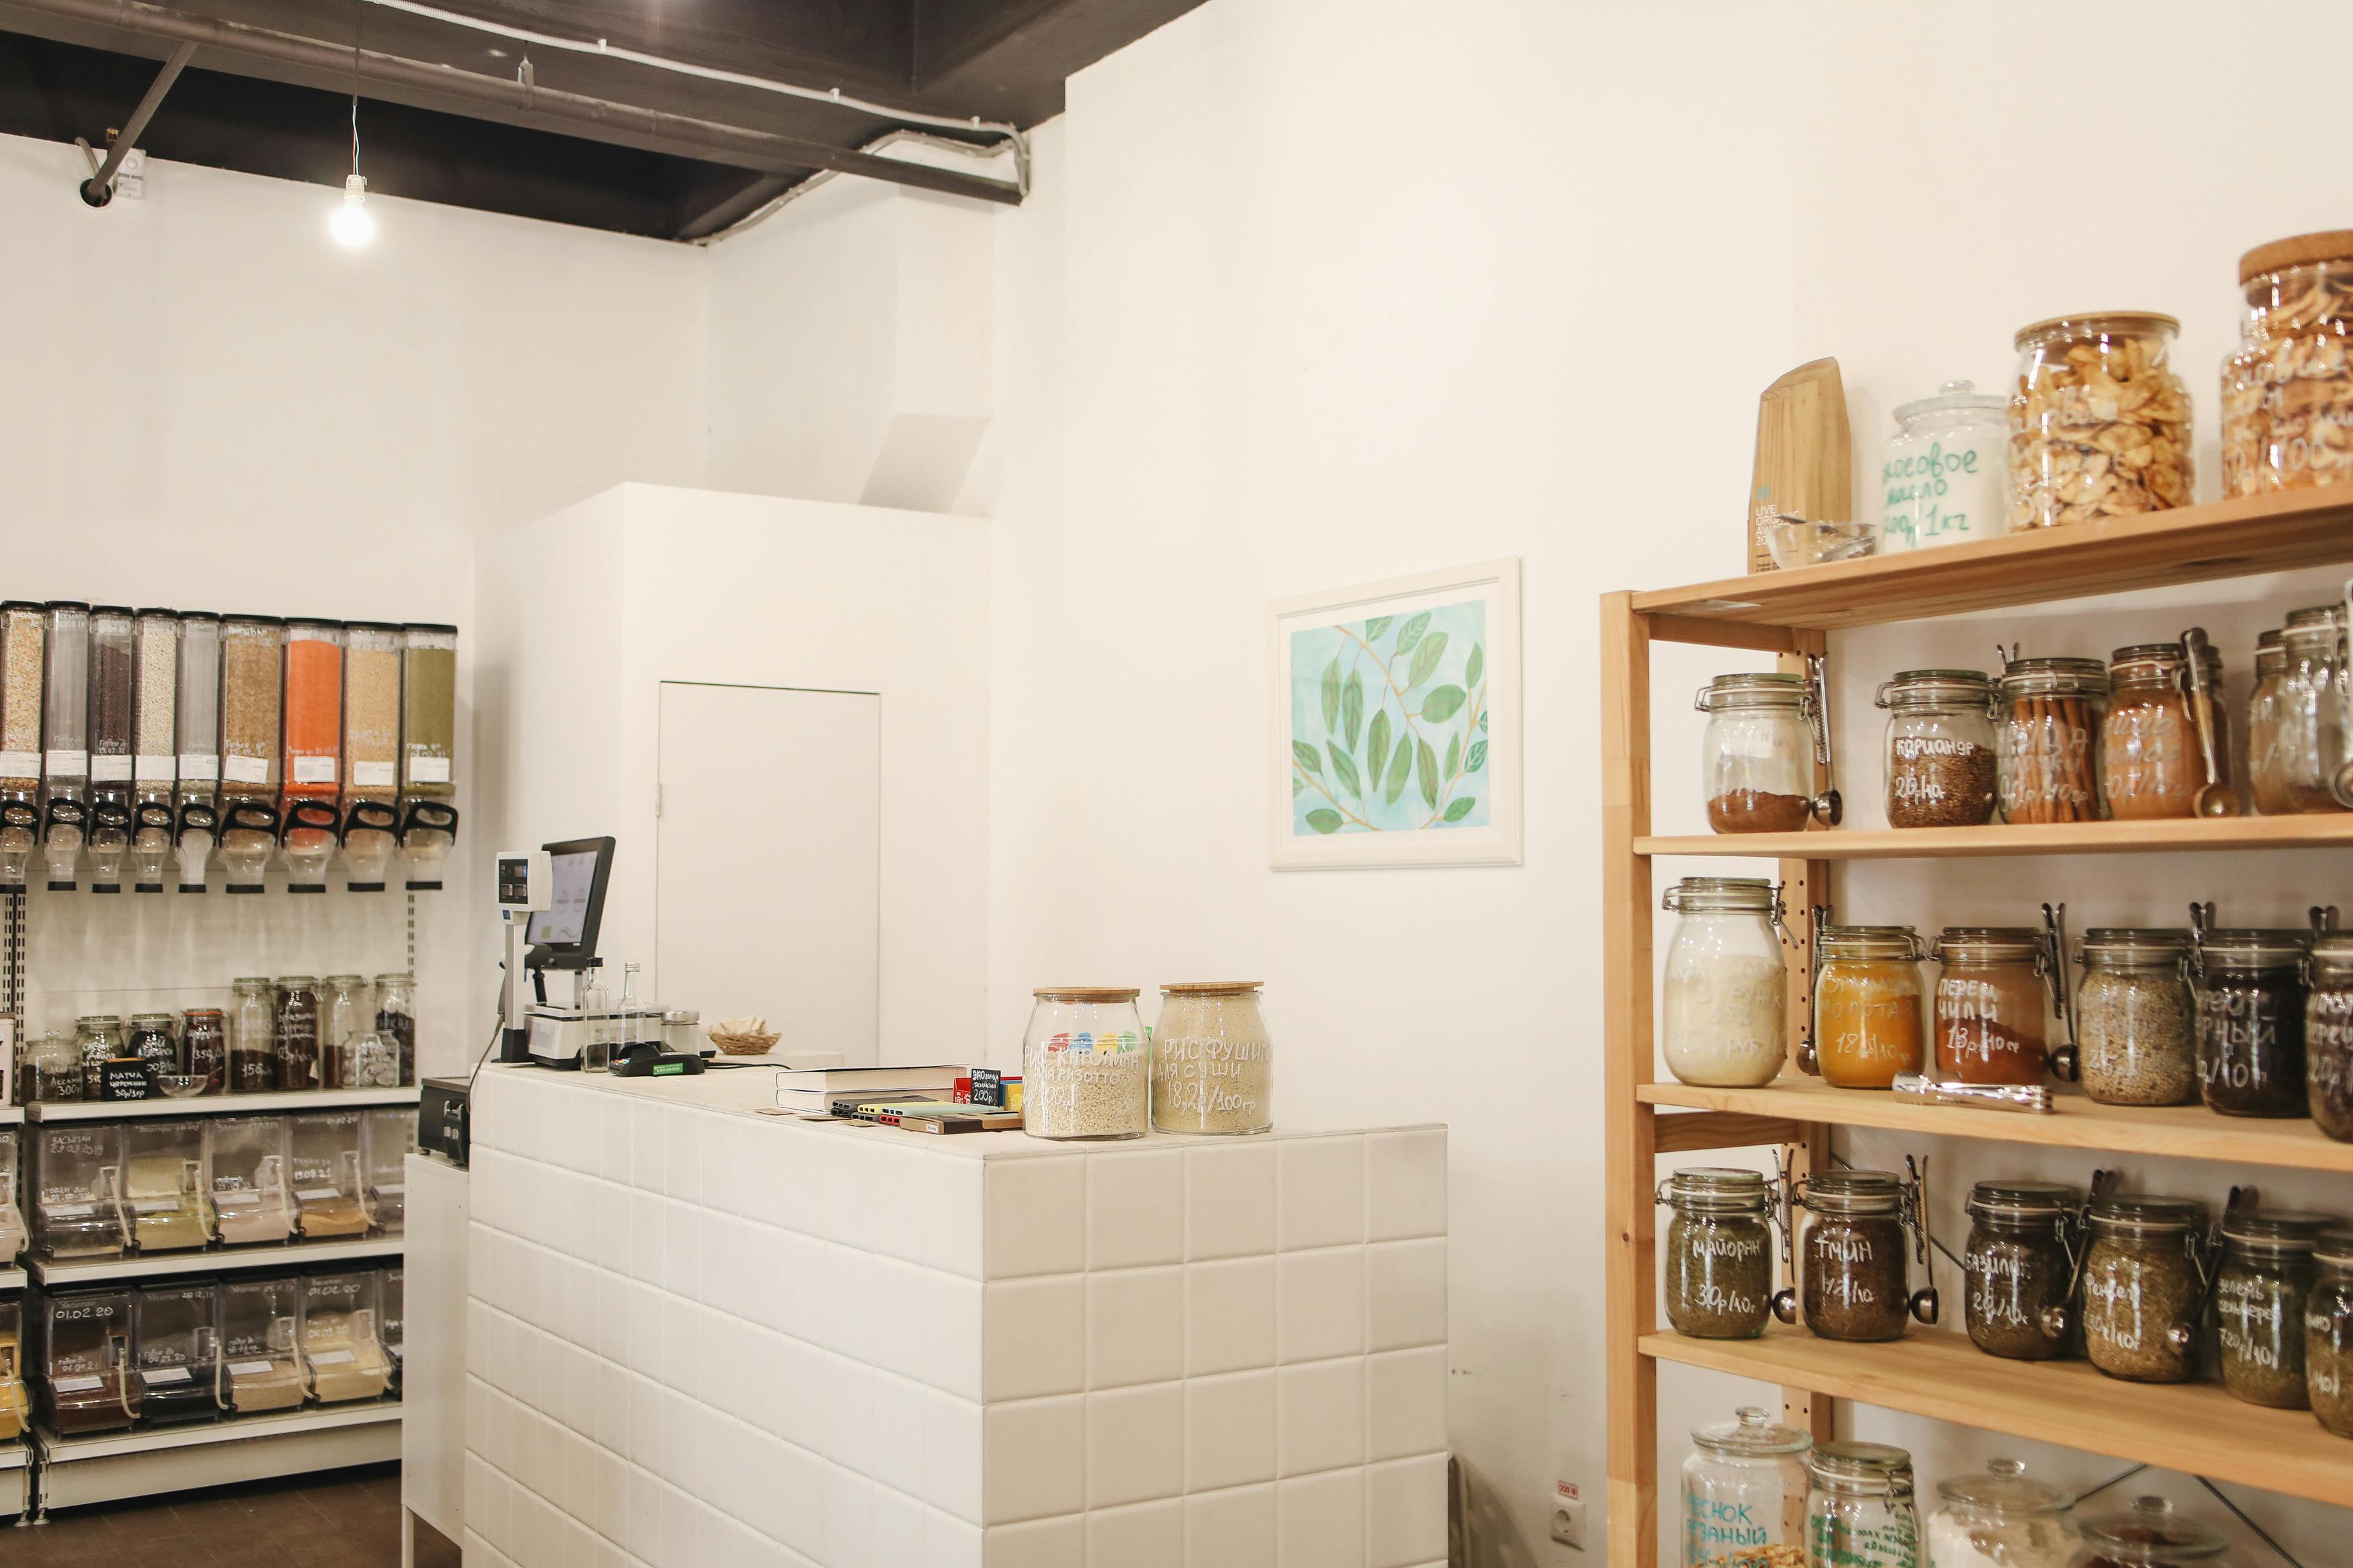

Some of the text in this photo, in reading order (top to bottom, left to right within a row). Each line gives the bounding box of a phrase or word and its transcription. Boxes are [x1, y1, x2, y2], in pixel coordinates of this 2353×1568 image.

[1755, 504, 1776, 517] LIVE
[1164, 1038, 1200, 1062] РИС
[110, 1072, 144, 1080] МАТЧА
[1814, 1237, 1874, 1263] ТМИН
[56, 1307, 114, 1319] 01.02.20
